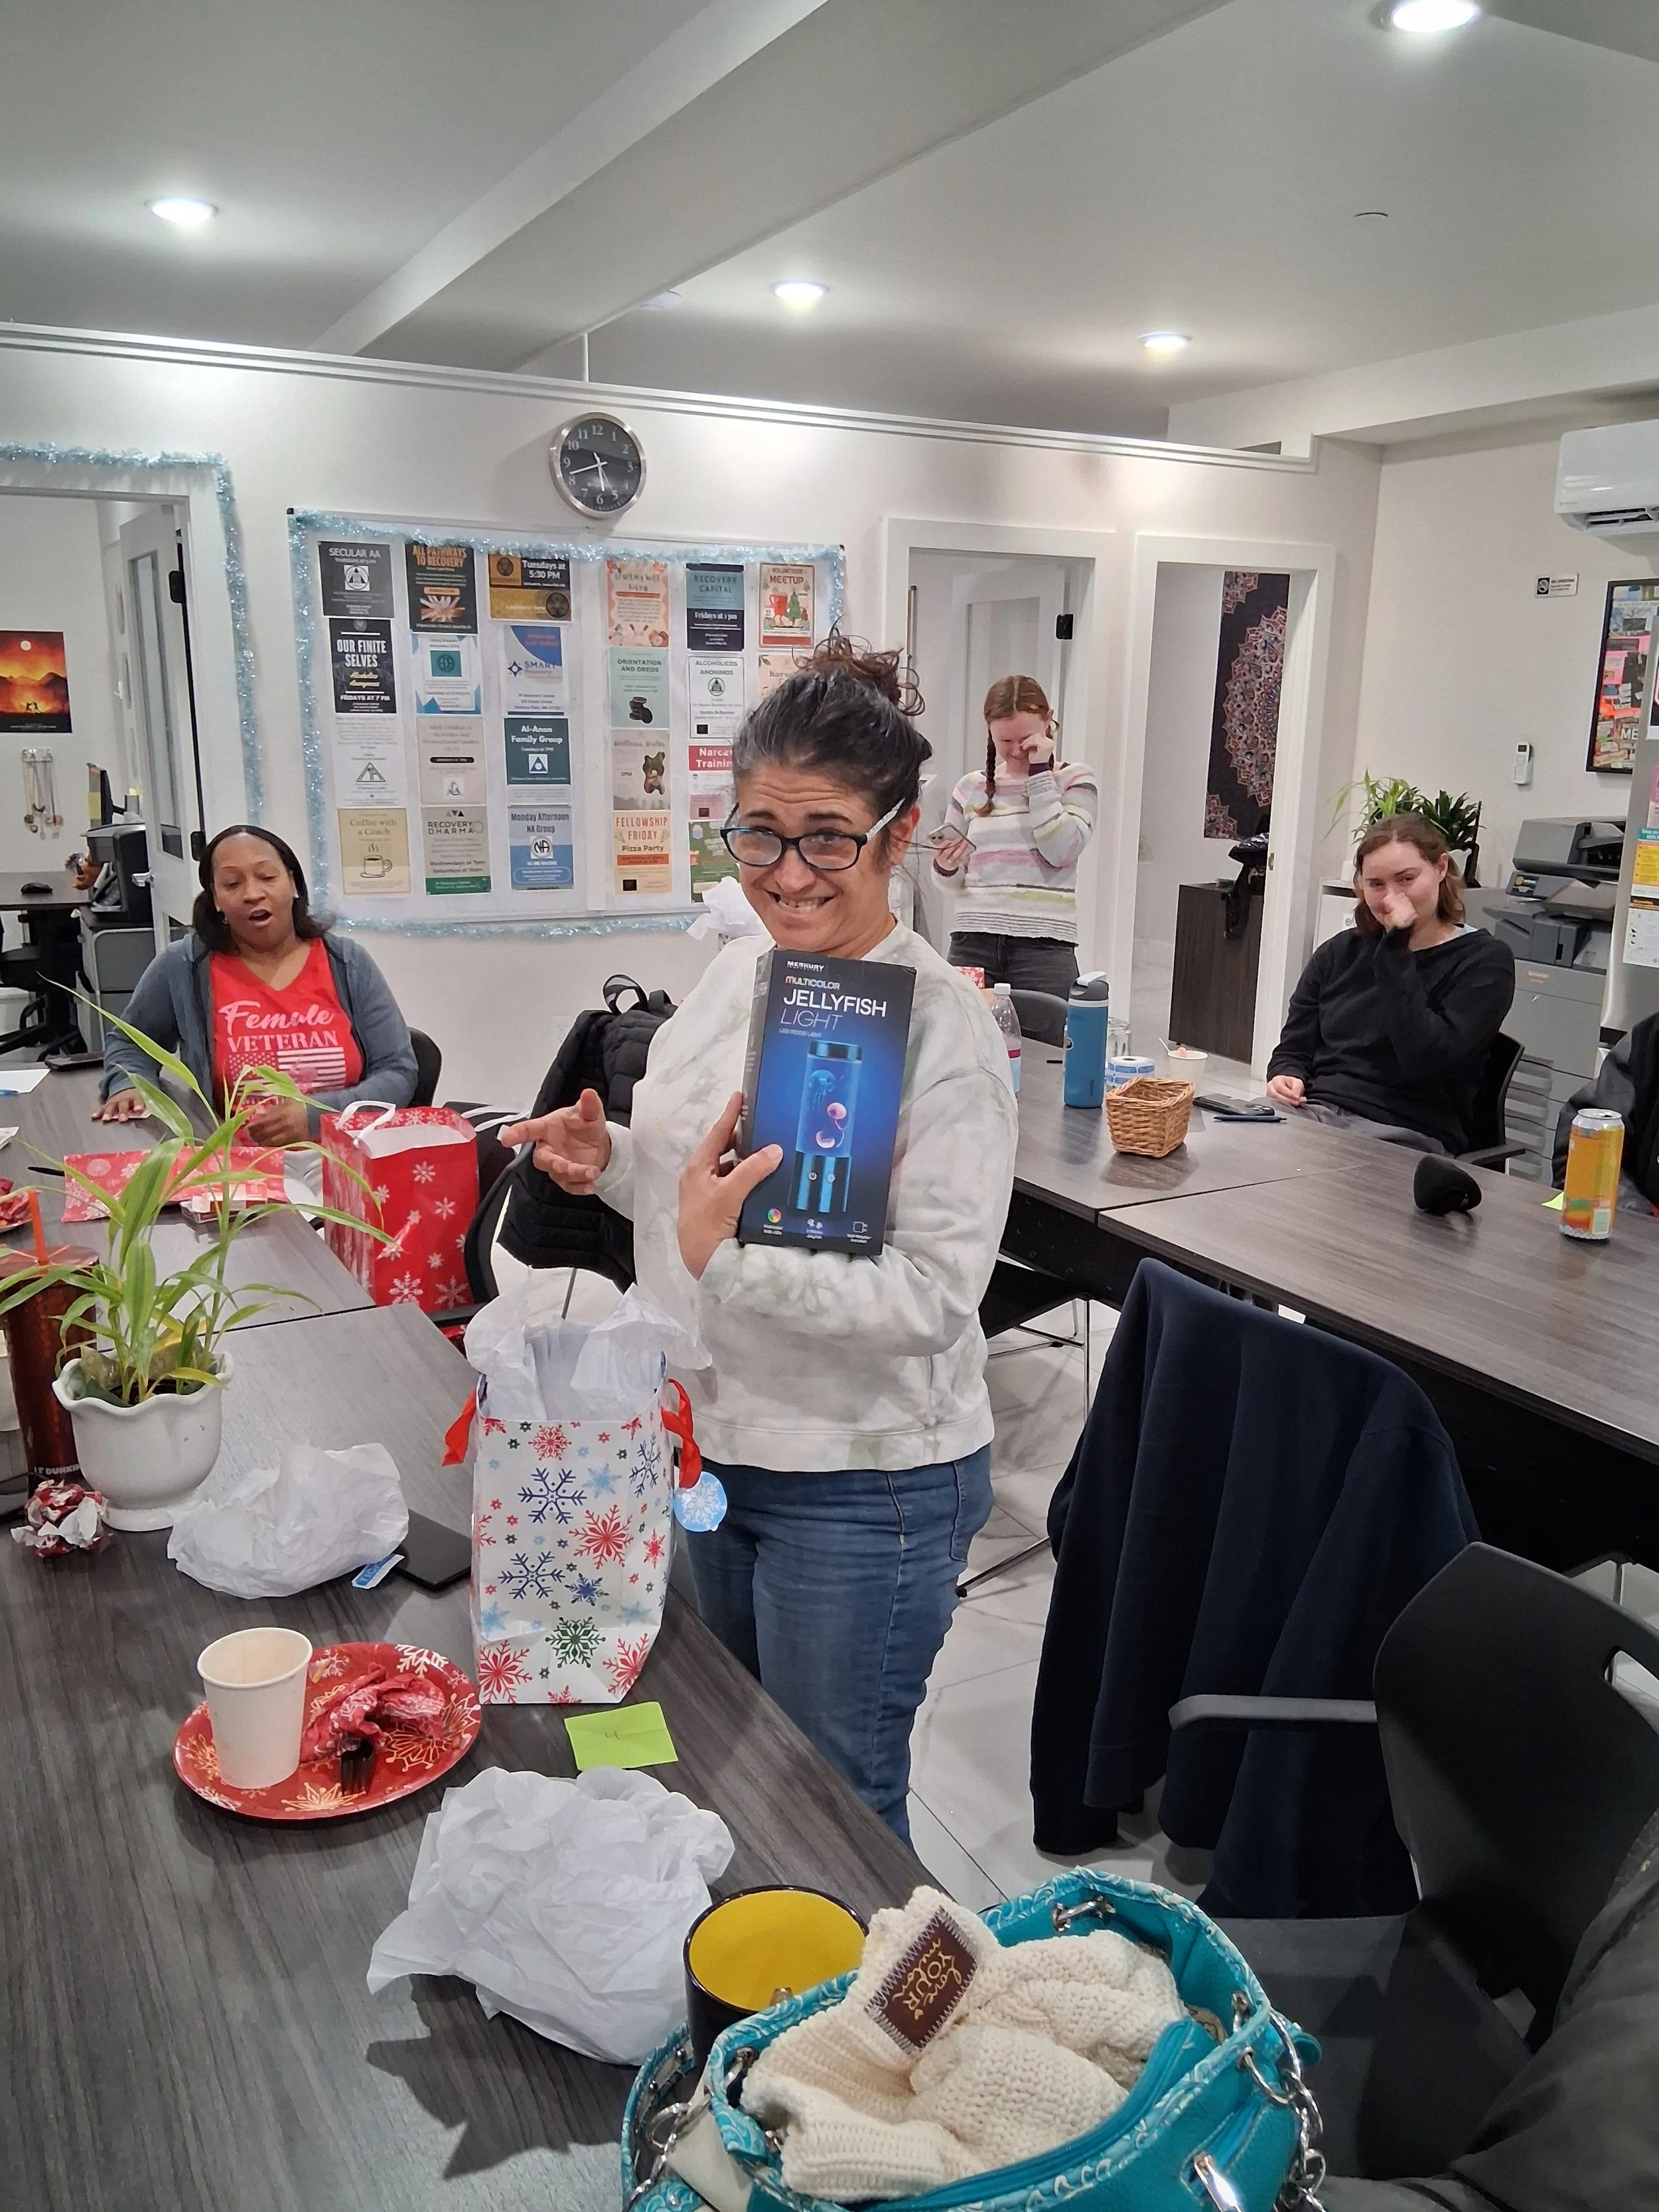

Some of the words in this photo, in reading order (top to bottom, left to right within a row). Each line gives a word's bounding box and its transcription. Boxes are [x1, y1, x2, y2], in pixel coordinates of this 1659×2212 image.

[578, 429, 589, 439] 11
[591, 425, 603, 435] 12
[611, 431, 616, 441] 1
[567, 440, 579, 451] 10
[622, 444, 629, 454] 2
[563, 457, 571, 468] 9
[626, 461, 634, 473] 3
[569, 476, 576, 486] 8
[581, 488, 589, 498] 7
[612, 490, 618, 500] 5
[596, 494, 604, 504] 6
[328, 548, 367, 557] SECULAR
[369, 550, 381, 558] AA
[416, 556, 426, 566] TO
[427, 557, 464, 567] RECOVERY
[522, 559, 557, 571] Tuesdays
[528, 570, 545, 579] 5:30
[547, 571, 561, 579] PM
[693, 575, 737, 583] RECOVERY
[770, 575, 804, 584] MEETUP
[699, 585, 733, 593] CAPITAL
[336, 639, 356, 652] OUR
[358, 640, 387, 654] FINITE
[345, 654, 378, 667] SELVES
[511, 735, 537, 744] Family
[539, 735, 563, 745] Group
[695, 759, 733, 768] Trainin
[511, 813, 536, 822] Monday
[616, 816, 668, 827] FELLOWSHIP
[536, 825, 555, 834] Group
[628, 830, 658, 840] FRIDAY
[534, 840, 549, 853] NA
[786, 960, 824, 972] MERKURY
[785, 976, 840, 990] MULTICOLOR
[782, 988, 887, 1017] JELLYFISH
[218, 1000, 334, 1035] Female
[780, 1007, 843, 1031] LIGHT
[226, 1030, 338, 1053] VETERAN
[892, 1938, 942, 2002] melon
[903, 1951, 953, 2010] YOUR
[923, 1956, 962, 2007] love
